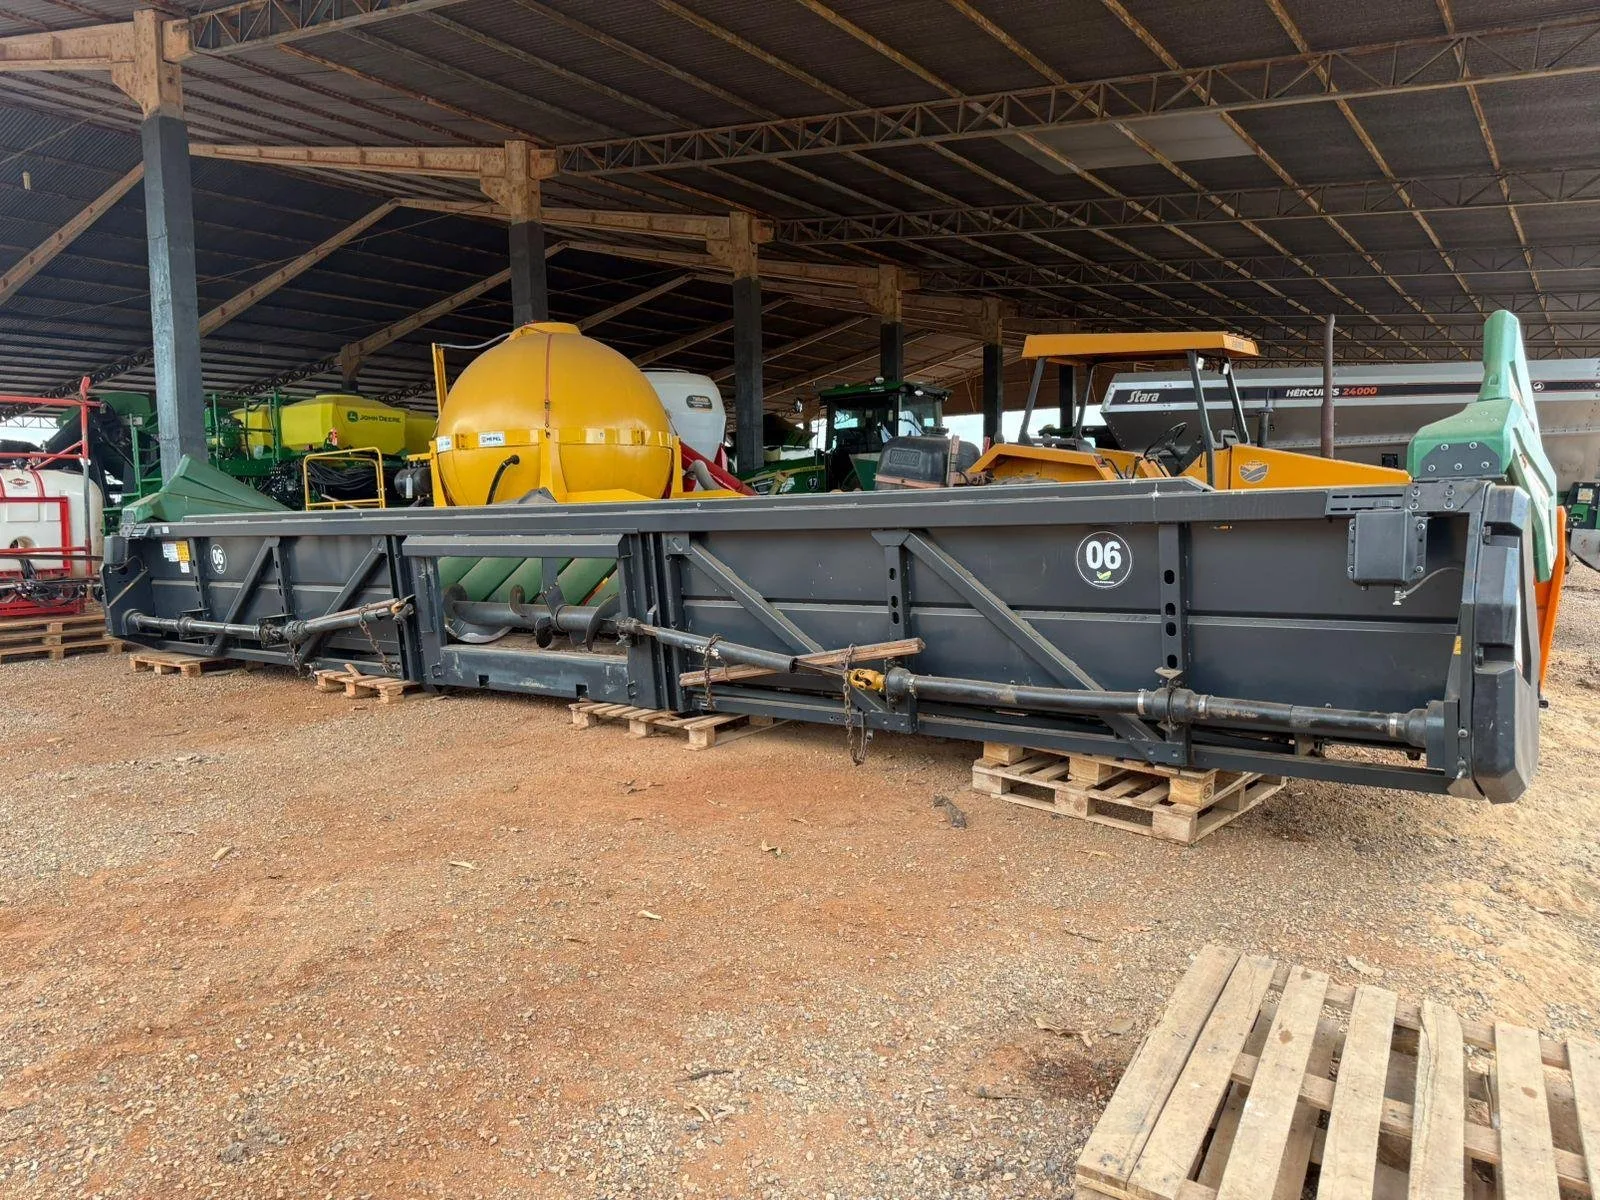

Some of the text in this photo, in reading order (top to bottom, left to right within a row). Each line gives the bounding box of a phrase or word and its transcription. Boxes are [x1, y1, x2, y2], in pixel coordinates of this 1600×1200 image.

[1127, 390, 1160, 403] Stara
[1342, 386, 1377, 396] 24000
[379, 415, 401, 423] DEERE
[808, 477, 818, 486] 17
[212, 549, 224, 565] 06
[1085, 540, 1122, 570] 06
